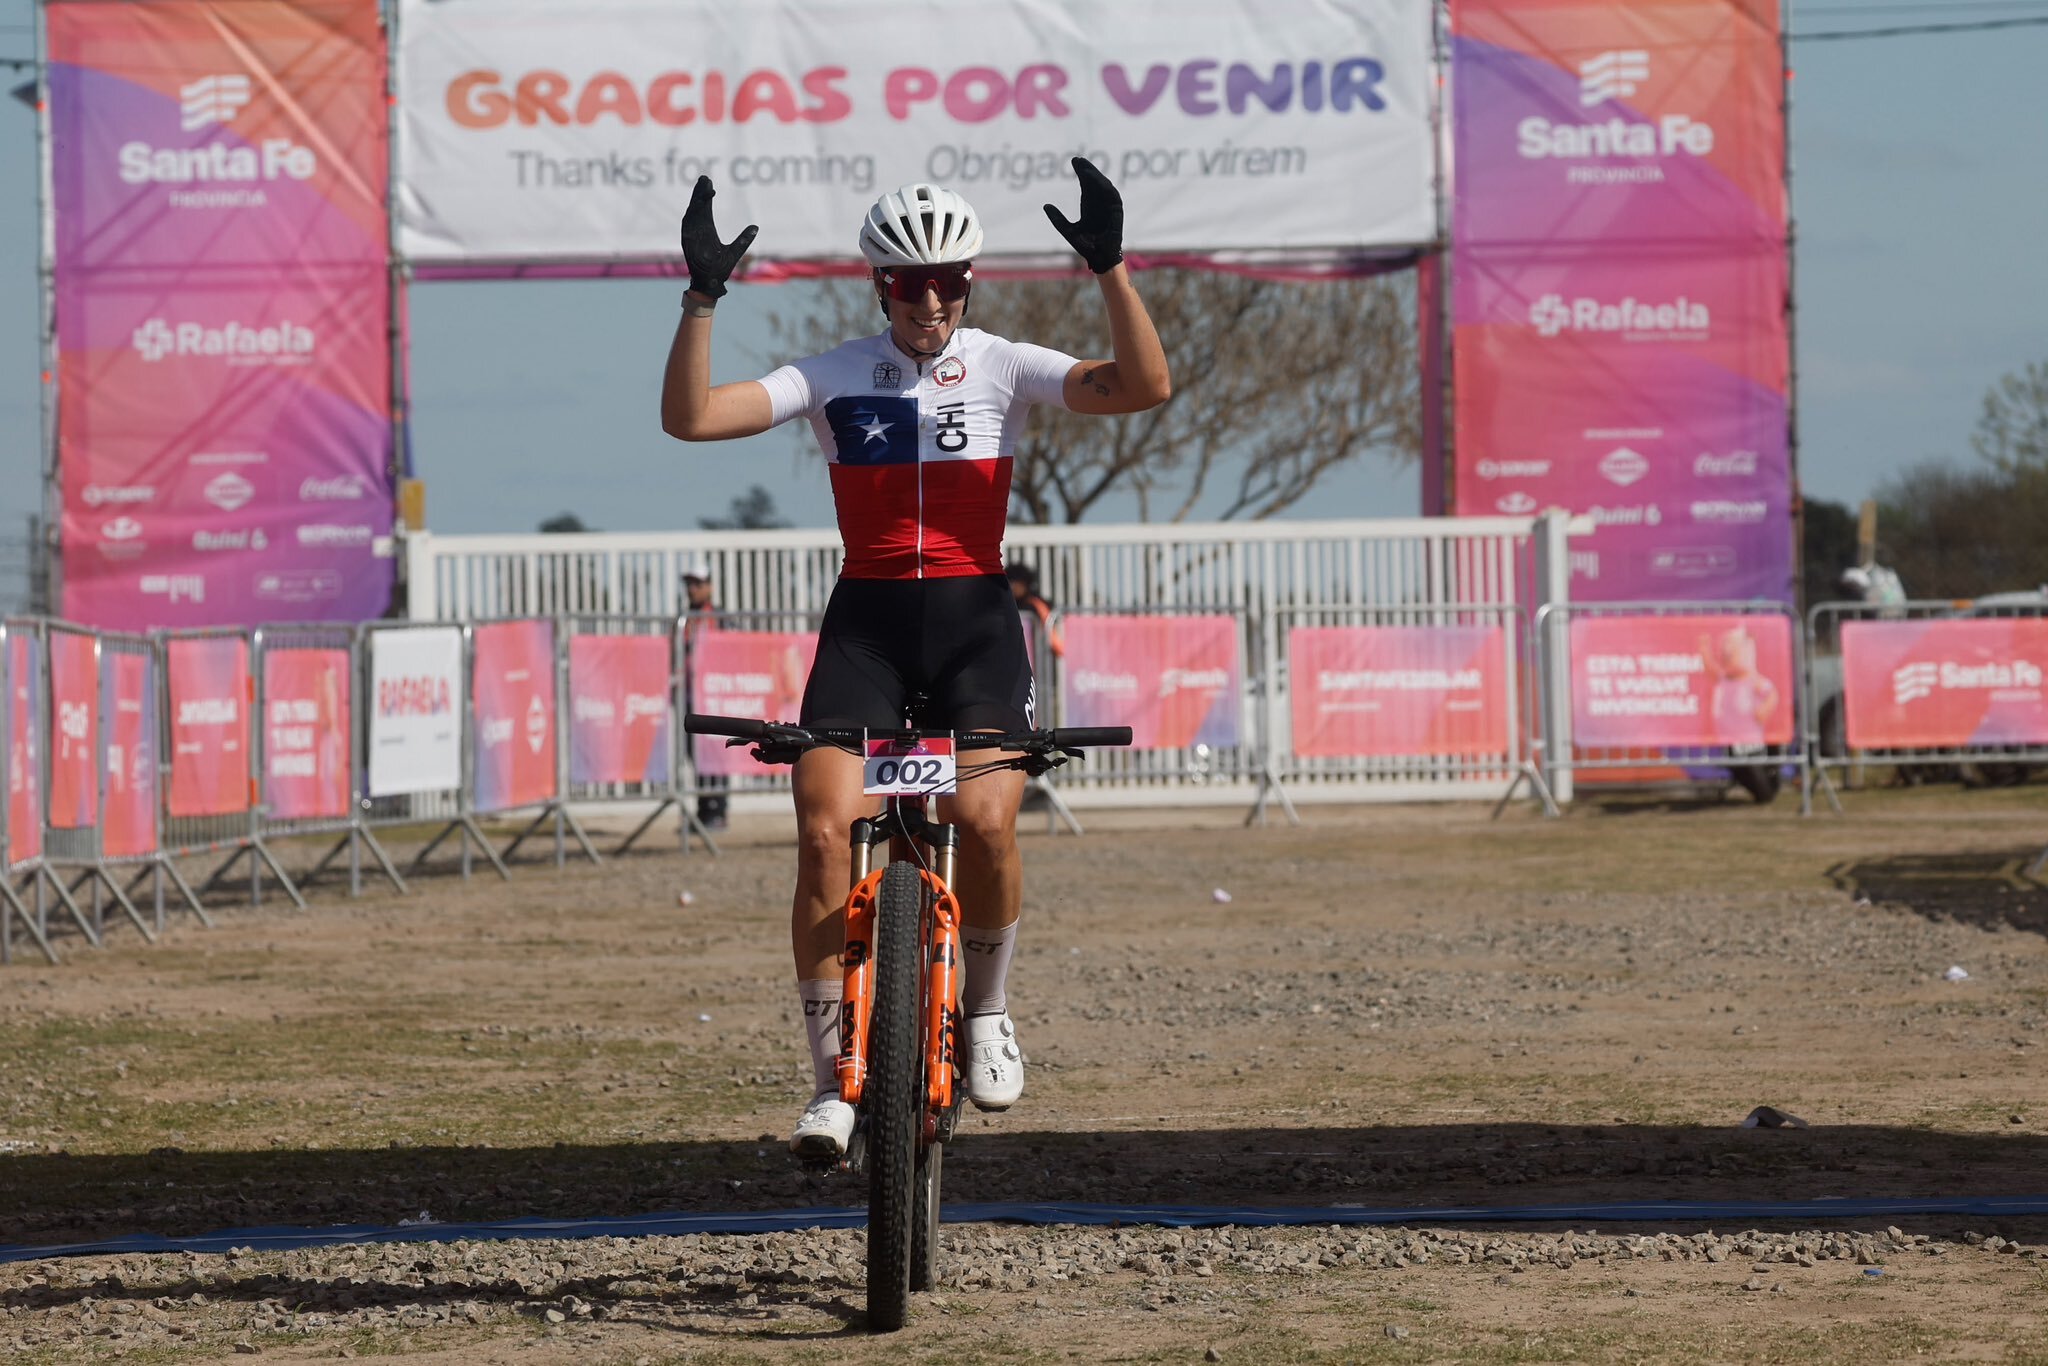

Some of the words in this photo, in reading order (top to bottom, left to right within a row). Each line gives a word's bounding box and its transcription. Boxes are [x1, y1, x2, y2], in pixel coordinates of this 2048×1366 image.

[446, 65, 852, 128] GRACIAS
[884, 63, 1071, 123] POR
[1101, 57, 1387, 118] VENIR
[1517, 116, 1656, 158] Santa
[1660, 114, 1714, 156] Fe
[119, 141, 257, 183] Santa
[262, 139, 316, 181] Fe
[509, 150, 654, 188] Thanks
[665, 147, 718, 187] for
[728, 150, 875, 190] coming
[1119, 148, 1188, 184] por
[1197, 140, 1307, 177] virem
[1568, 167, 1664, 183] PROVINCIA
[169, 190, 266, 207] PROVINCIA
[1573, 297, 1709, 331] Rafaela
[177, 321, 314, 355] Rafaela
[936, 401, 968, 453] CHI
[876, 760, 942, 785] 002
[966, 940, 1003, 955] CT
[805, 999, 838, 1017] CT
